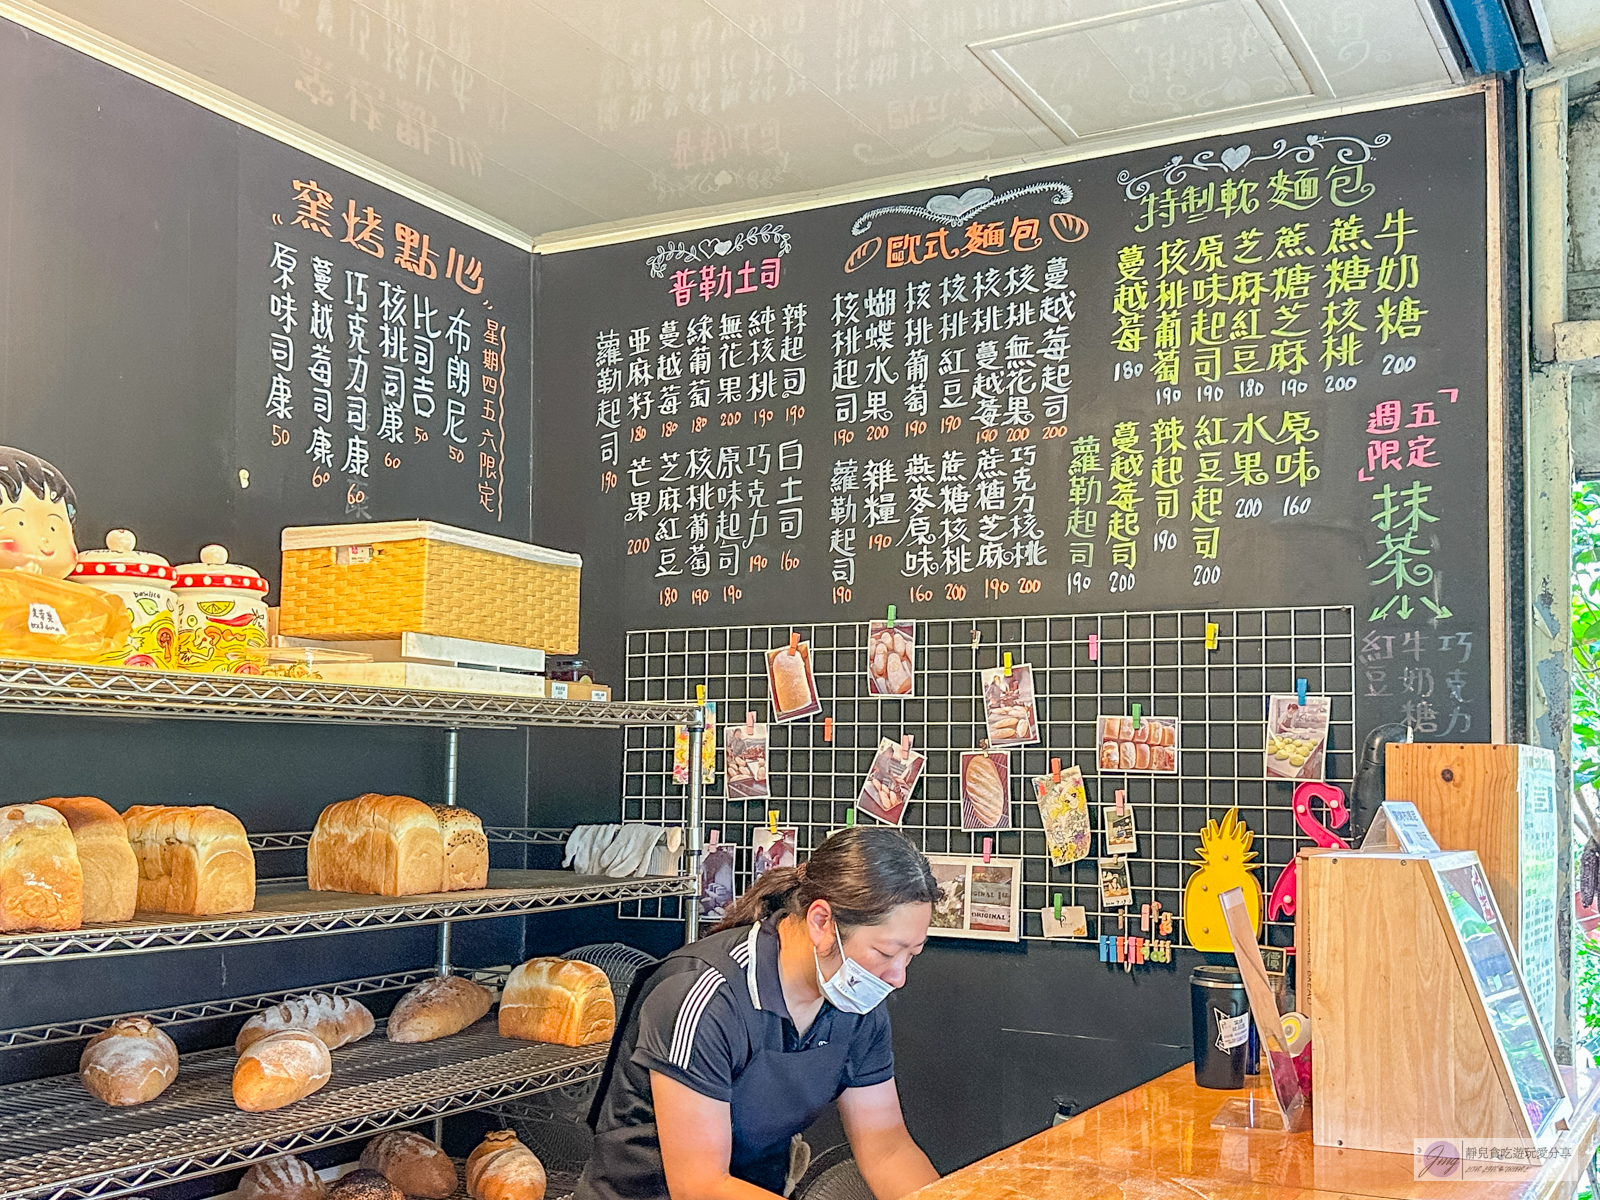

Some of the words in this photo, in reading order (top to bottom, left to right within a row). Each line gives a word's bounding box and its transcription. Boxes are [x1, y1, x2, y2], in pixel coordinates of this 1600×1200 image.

[886, 215, 1043, 268] 歐式麵包
[669, 257, 781, 307] 普勒土司
[1112, 244, 1149, 352] 蔓越莓
[1226, 227, 1269, 376] 芝麻紅豆
[1319, 214, 1374, 372] 蔗糖核桃
[1373, 207, 1429, 345] 牛奶糖
[265, 242, 297, 418] 原味司康
[1151, 237, 1189, 385] 核桃葡萄
[1189, 233, 1231, 382] 原味起司
[306, 256, 334, 467] 蔓越莓司康
[377, 280, 408, 443] 核桃司康
[413, 294, 441, 418] 比司吉
[717, 313, 745, 404] 無花果
[746, 306, 777, 401] 純核桃
[780, 302, 808, 398] 辣起司
[830, 292, 862, 423] 核桃起司
[860, 287, 899, 422] 蝴蝶水果
[903, 281, 934, 416] 核桃葡萄
[938, 273, 969, 409] 核桃紅豆
[969, 267, 1003, 428] 核桃蔓越莓
[1001, 264, 1039, 426] 核桃無花果
[1036, 256, 1077, 424] 蔓越莓起司
[1382, 354, 1416, 375] 200
[341, 271, 370, 477] 巧克力司康
[443, 308, 471, 443] 布朗尼
[626, 327, 654, 420] 亞麻籽
[657, 320, 684, 415] 蔓越莓
[1113, 361, 1143, 381] 180
[1197, 385, 1223, 402] 190
[1240, 378, 1264, 398] 180
[1281, 378, 1308, 397] 190
[1325, 376, 1357, 392] 200
[478, 318, 499, 512] 星期四五六限定
[595, 329, 624, 466] 蘿勒起司
[720, 412, 742, 426] 200
[754, 408, 773, 427] 190
[785, 405, 805, 425] 190
[1156, 387, 1181, 404] 190
[272, 425, 290, 446] 50
[415, 427, 428, 443] 50
[630, 426, 647, 442] 180
[661, 421, 678, 437] 180
[691, 417, 707, 432] 180
[833, 429, 855, 446] 190
[866, 425, 889, 440] 200
[905, 420, 927, 437] 190
[940, 416, 961, 433] 190
[976, 428, 998, 444] 190
[1006, 428, 1030, 442] 200
[1042, 426, 1067, 439] 200
[1226, 413, 1276, 487] 水果
[1275, 411, 1320, 487] 原味
[312, 466, 330, 487] 60
[385, 453, 401, 469] 60
[449, 445, 464, 463] 50
[1150, 416, 1187, 525] 辣起司
[347, 484, 365, 504] 60
[601, 471, 617, 493] 190
[624, 457, 652, 521] 芒果
[742, 443, 771, 549] 巧克力
[776, 439, 803, 539] 白土司
[862, 458, 900, 528] 雜糧
[1008, 445, 1047, 568] 巧克力核桃
[1064, 435, 1103, 567] 蘿勒起司
[1105, 421, 1144, 570] 蔓越莓起司
[1190, 415, 1228, 559] 紅豆起司
[1235, 498, 1263, 518] 200
[1283, 496, 1311, 517] 160
[652, 452, 683, 577] 芝麻紅豆
[684, 447, 716, 576] 核桃葡萄
[714, 446, 743, 576] 原味起司
[828, 458, 860, 586] 蘿勒起司
[896, 453, 939, 577] 燕麥原味
[937, 449, 973, 575] 蔗糖核桃
[1366, 480, 1440, 590] 抹茶
[627, 537, 650, 555] 200
[750, 555, 768, 572] 190
[781, 550, 799, 571] 160
[868, 534, 892, 551] 190
[1154, 530, 1177, 551] 190
[659, 587, 678, 606] 180
[691, 589, 709, 605] 190
[723, 585, 742, 604] 190
[832, 586, 852, 604] 190
[910, 584, 933, 603] 160
[945, 583, 967, 601] 200
[984, 578, 1009, 599] 190
[1017, 578, 1041, 593] 200
[1067, 572, 1091, 596] 190
[1109, 572, 1135, 592] 200
[1193, 565, 1221, 586] 200
[1359, 630, 1394, 697] 紅豆
[1398, 630, 1438, 734] 牛奶糖
[1435, 632, 1473, 736] 巧克力
[971, 912, 1006, 921] ORIGINAL
